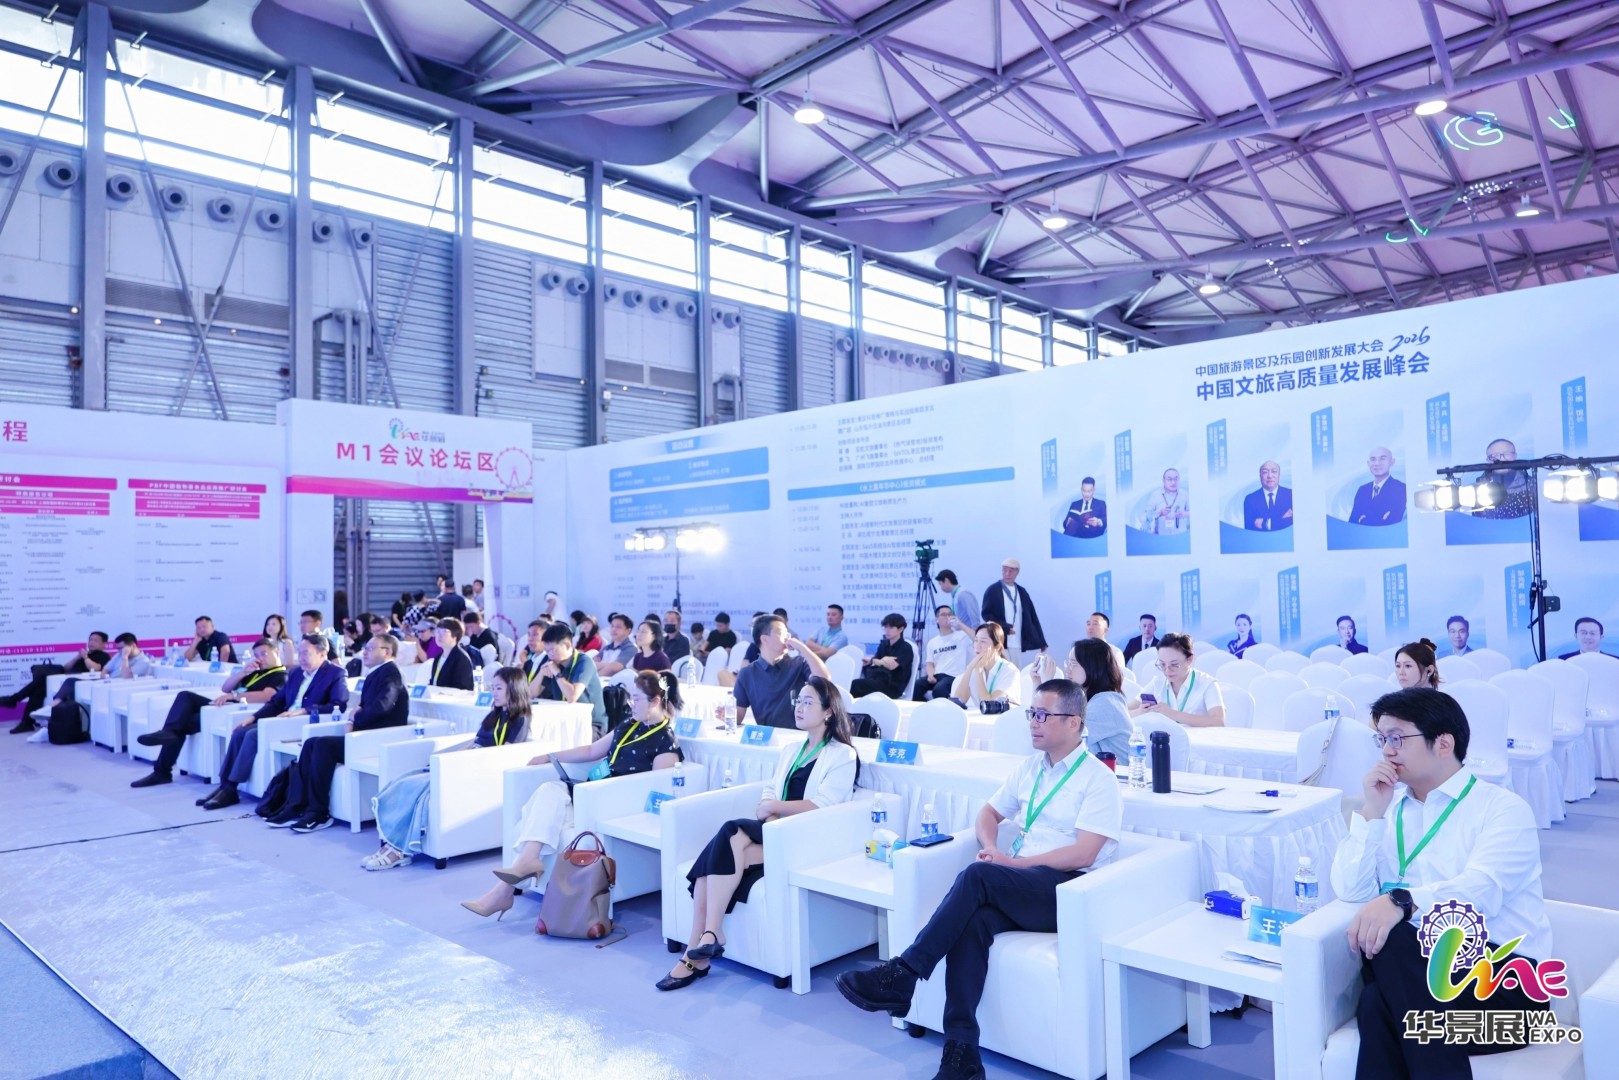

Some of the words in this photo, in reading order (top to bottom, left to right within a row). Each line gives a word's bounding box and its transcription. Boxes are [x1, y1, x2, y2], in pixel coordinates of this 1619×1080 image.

[1195, 339, 1383, 376] 中国旅游景区及乐园创新发展大会
[1388, 326, 1430, 352] 2026
[1196, 351, 1430, 401] 中国文旅高质量发展峰会
[3, 420, 28, 442] 程
[336, 442, 494, 472] M1会议论坛区
